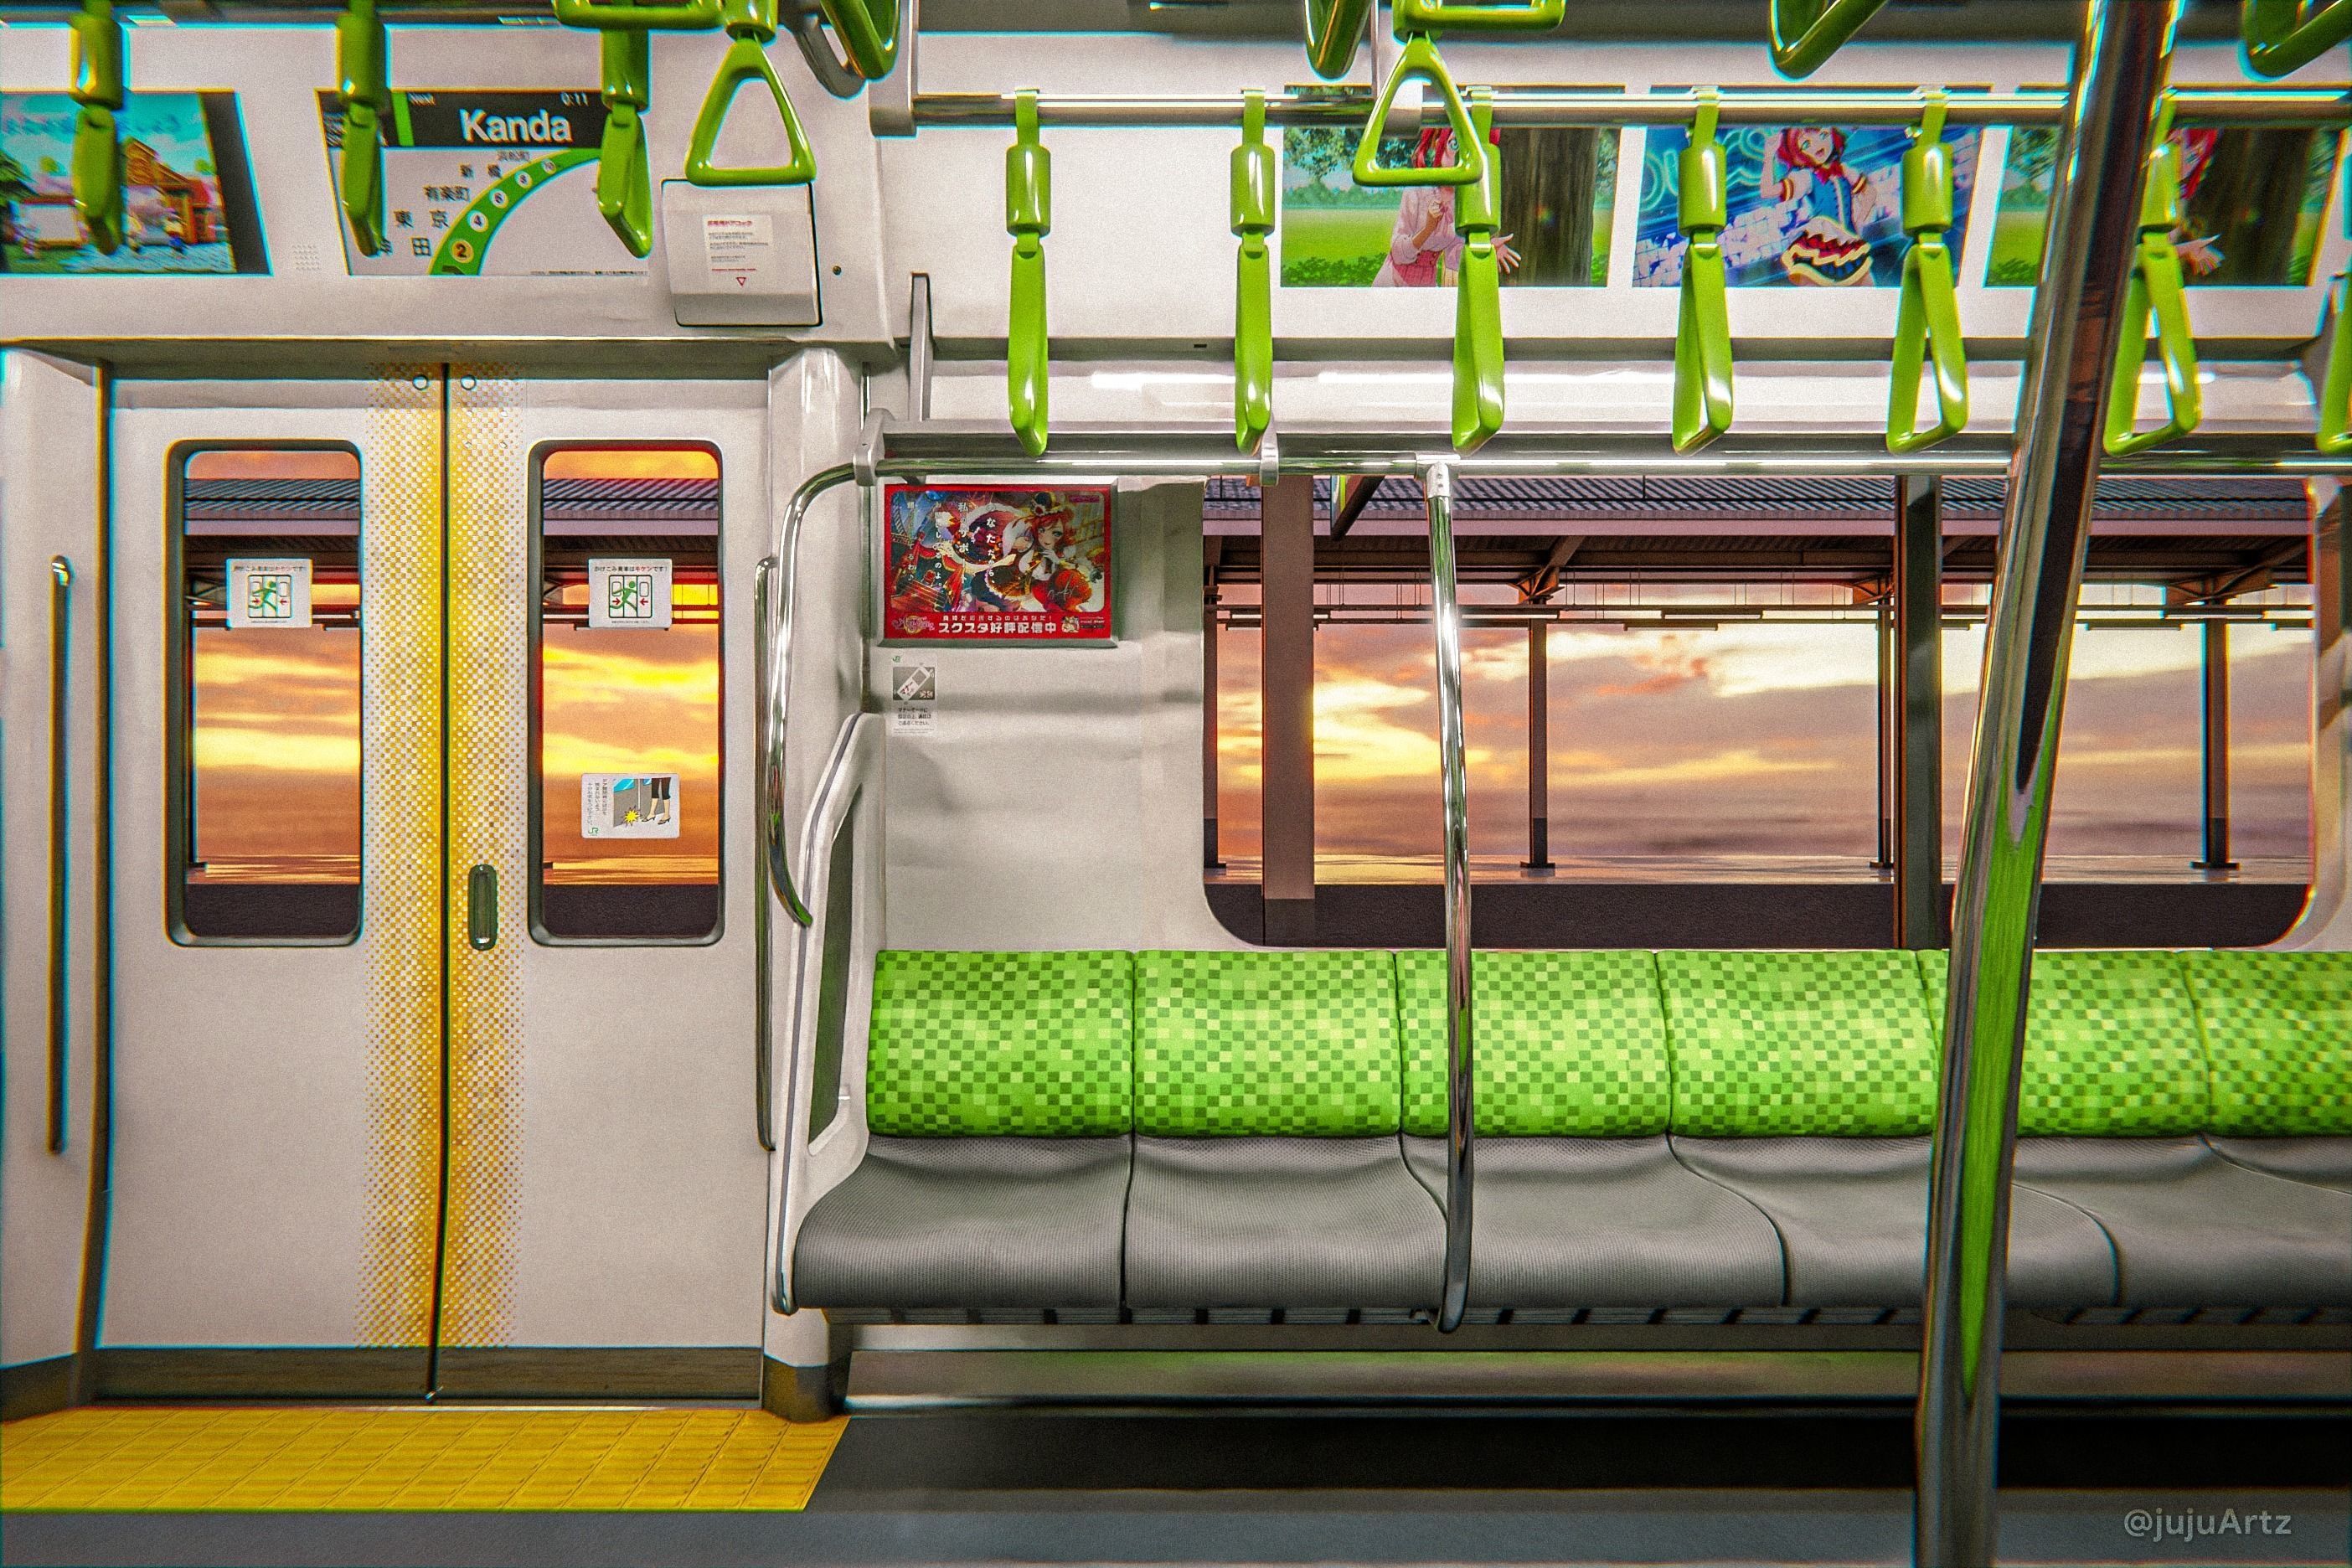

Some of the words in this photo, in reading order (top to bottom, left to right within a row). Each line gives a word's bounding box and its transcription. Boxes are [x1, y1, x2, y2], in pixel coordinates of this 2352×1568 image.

[459, 108, 574, 143] Kanda
[473, 214, 483, 227] 4
[456, 243, 467, 258] 2
[938, 622, 1057, 634] スクスタ好評配信中
